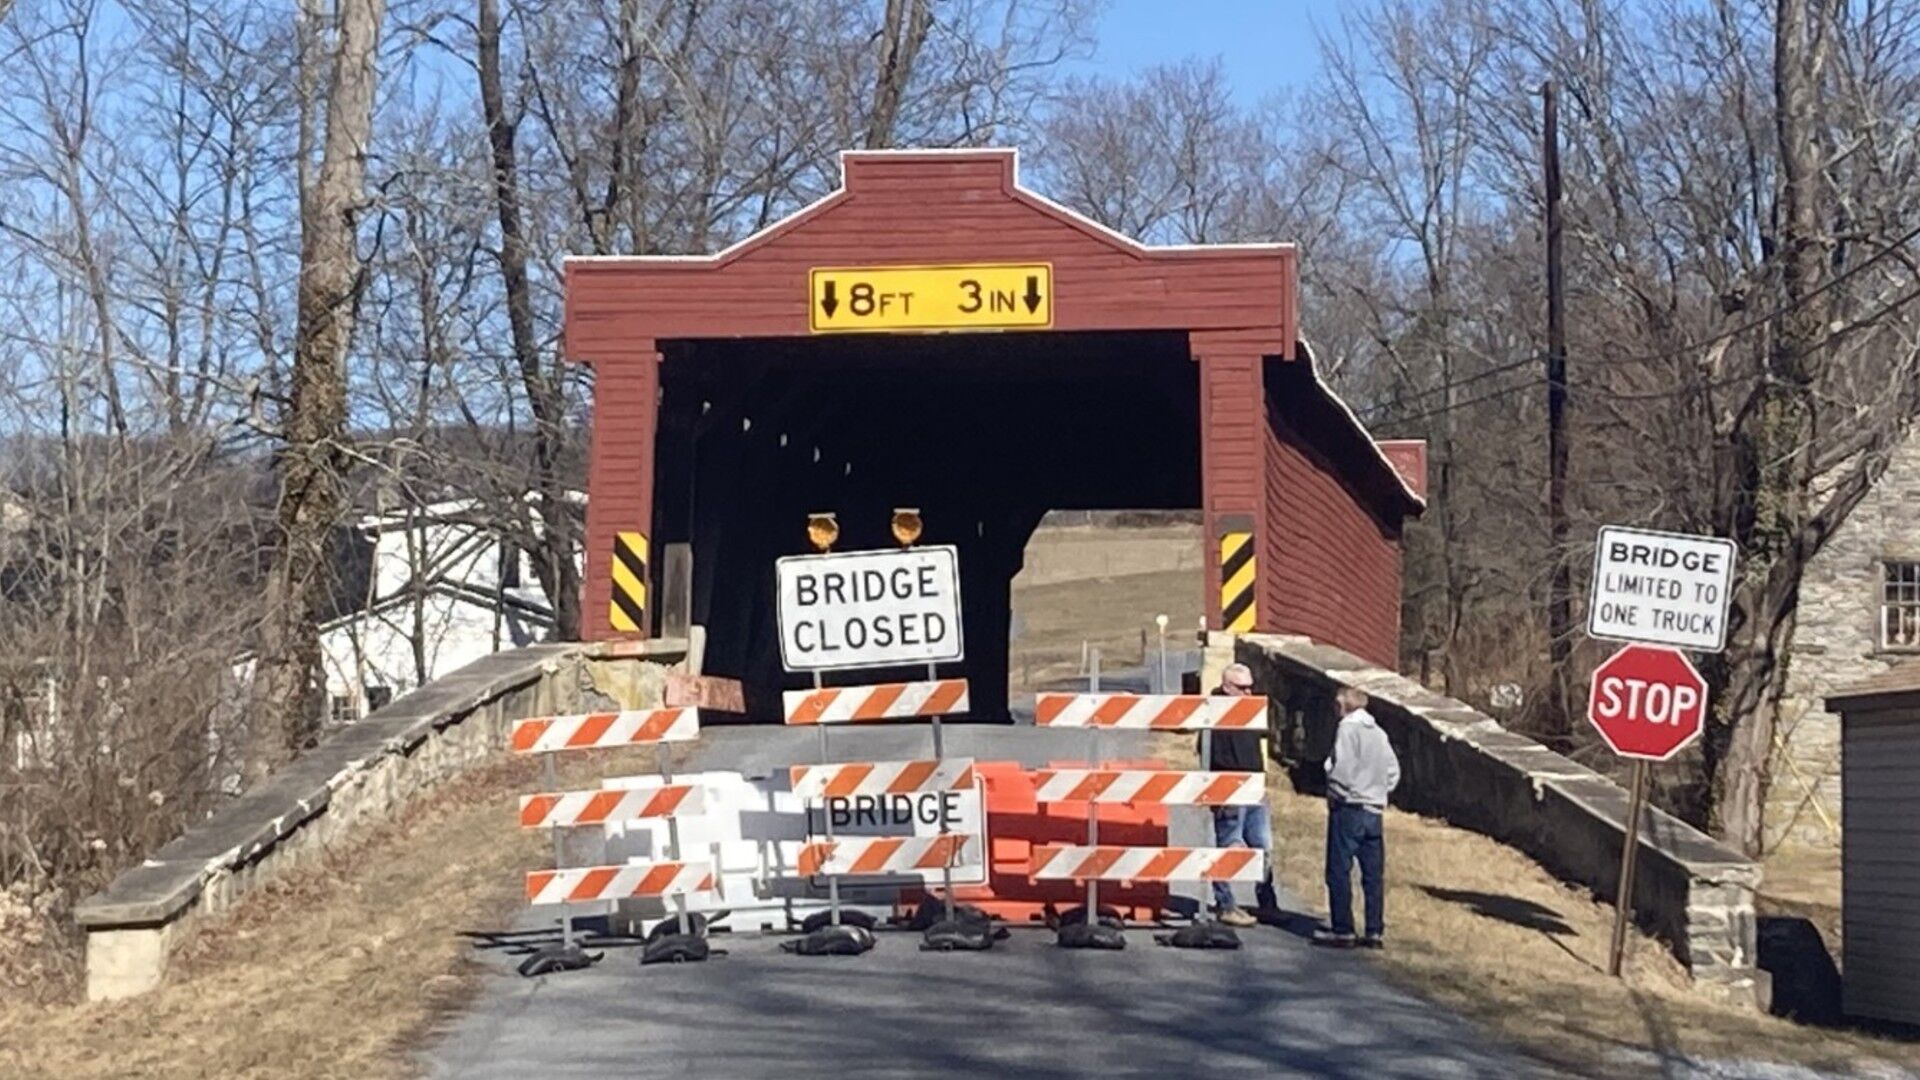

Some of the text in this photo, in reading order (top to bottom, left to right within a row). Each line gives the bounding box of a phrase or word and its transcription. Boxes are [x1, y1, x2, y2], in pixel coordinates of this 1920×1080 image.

[1609, 542, 1721, 573] BRIDGE
[796, 565, 939, 606] BRIDGE
[1605, 572, 1718, 605] LIMITED TO
[794, 612, 945, 653] CLOSED
[1601, 602, 1716, 635] ONE TRUCK
[1598, 677, 1697, 726] STOP
[831, 793, 962, 826] BRIDGE
